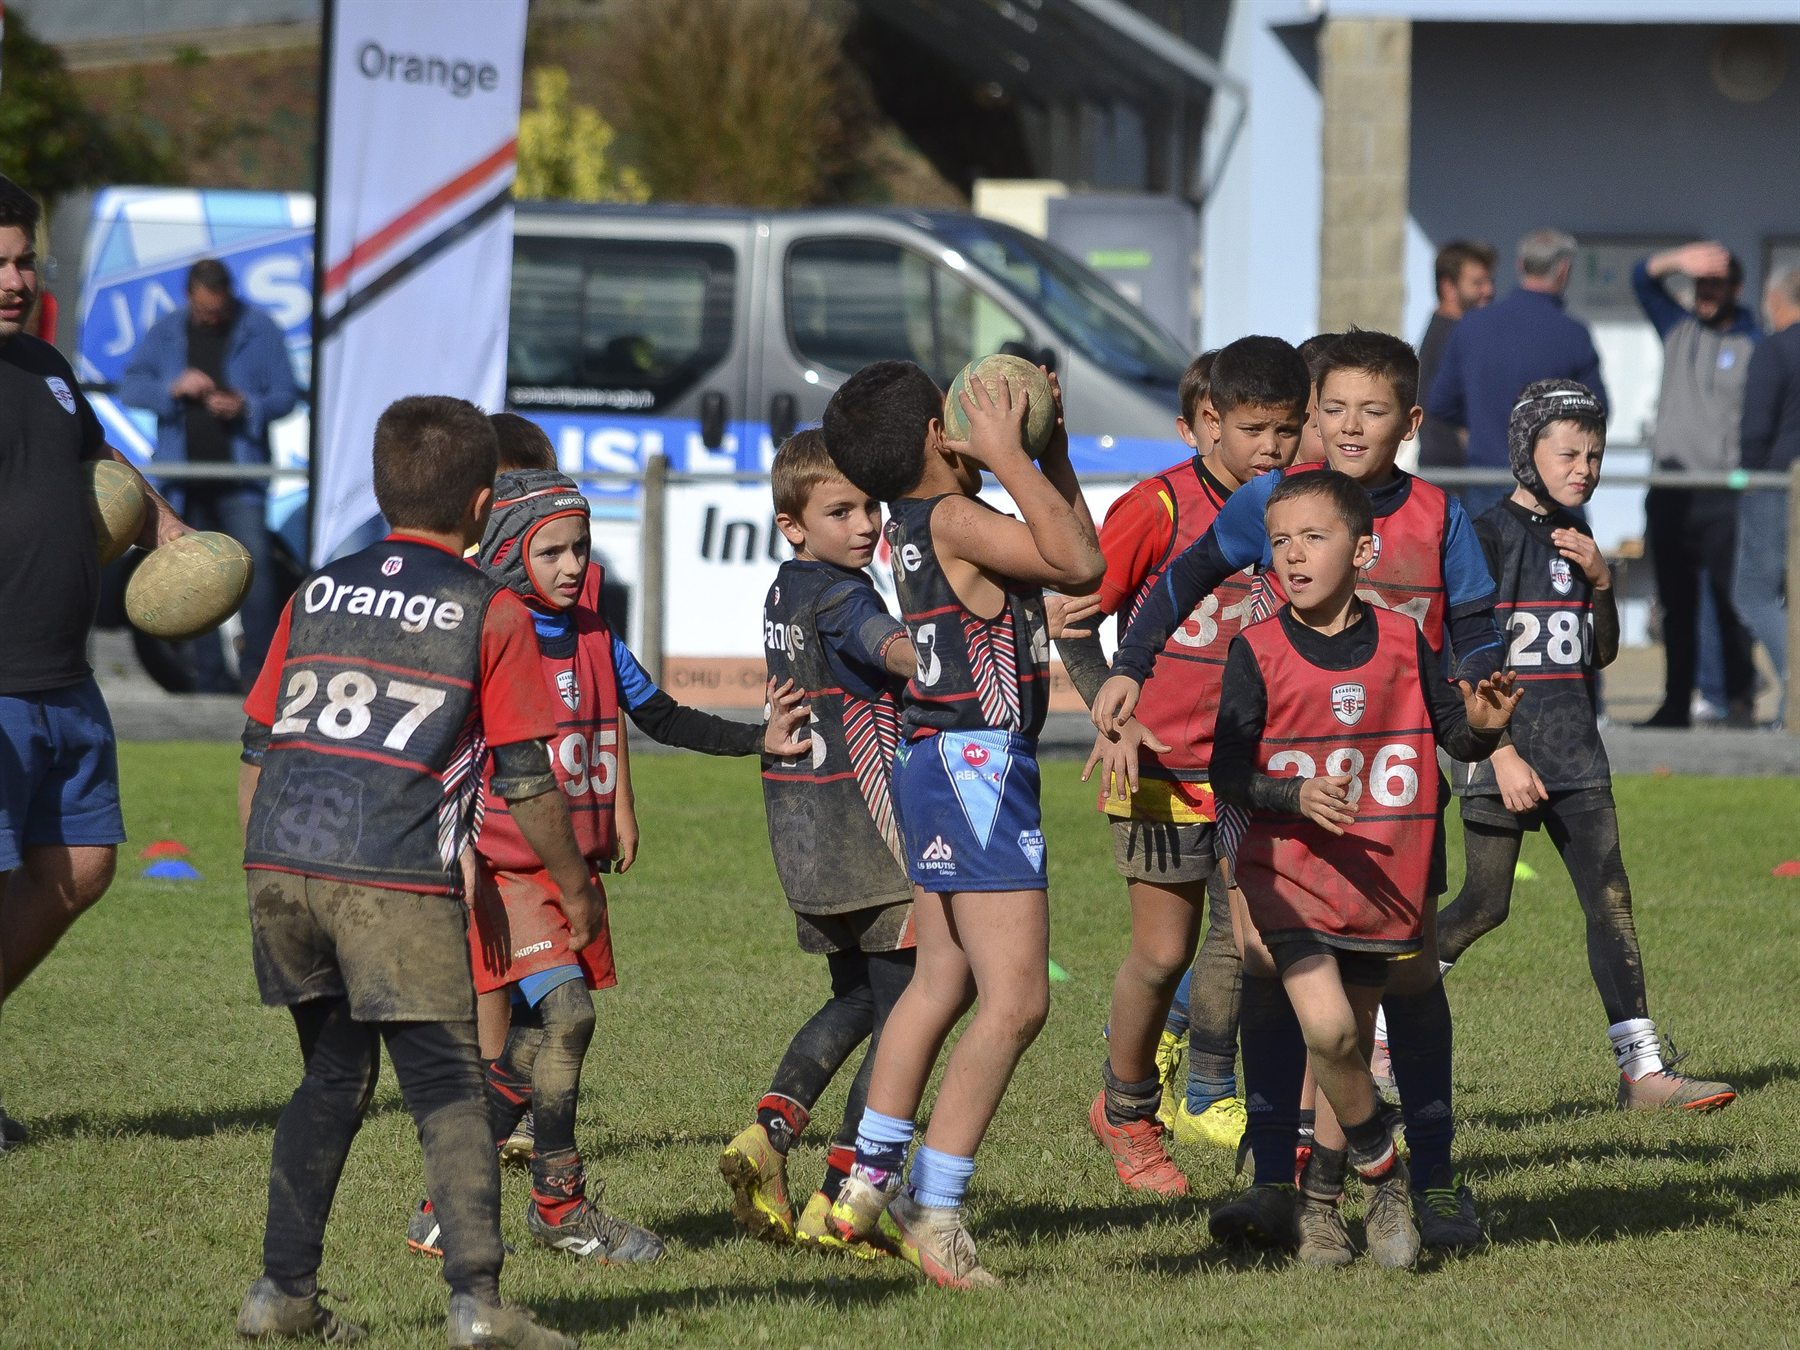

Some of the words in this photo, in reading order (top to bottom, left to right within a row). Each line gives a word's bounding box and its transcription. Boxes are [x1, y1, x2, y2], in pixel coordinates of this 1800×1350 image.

[357, 41, 498, 98] Orange
[303, 575, 465, 633] Orange
[271, 669, 447, 751] 287
[546, 729, 617, 797] 95
[1267, 743, 1419, 807] 286
